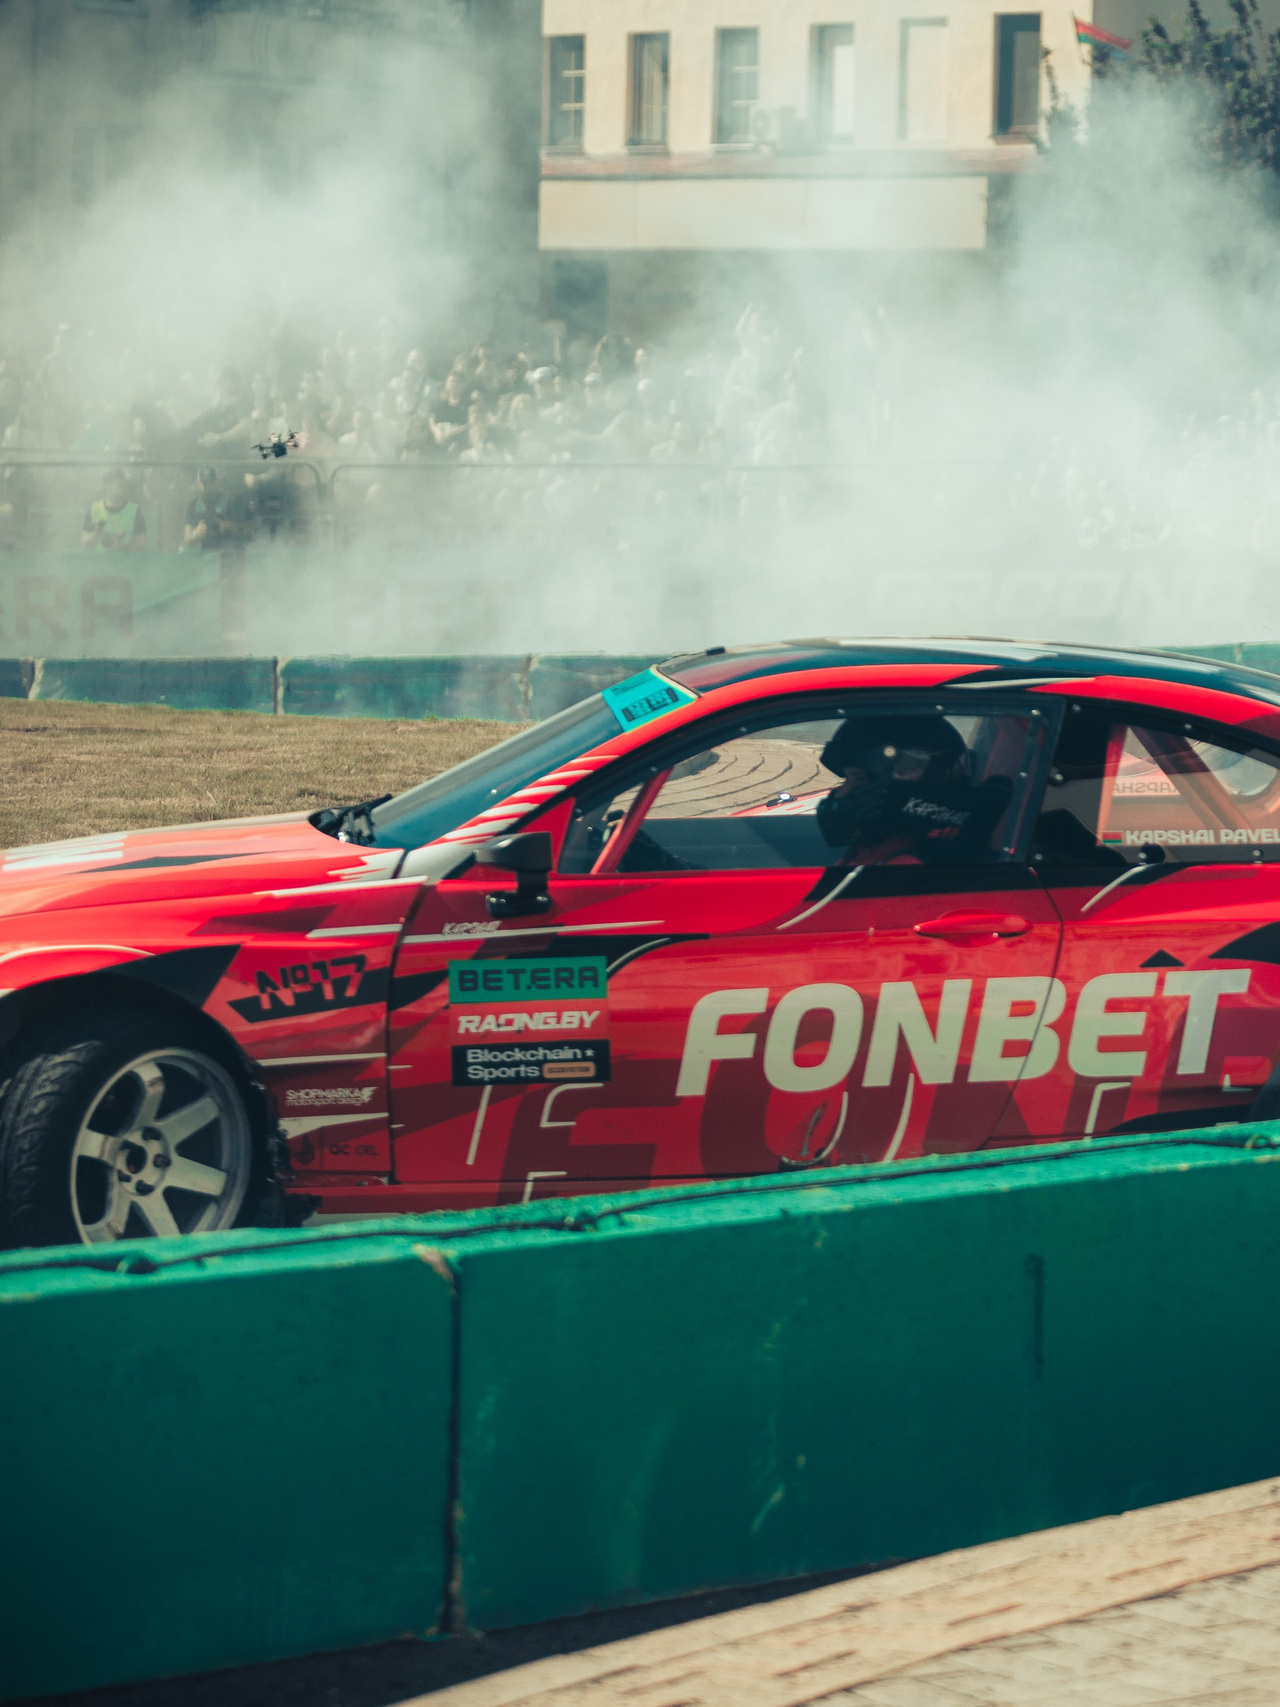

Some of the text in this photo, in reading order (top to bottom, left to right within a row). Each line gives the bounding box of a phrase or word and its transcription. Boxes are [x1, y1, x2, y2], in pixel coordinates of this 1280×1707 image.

[0, 576, 134, 640] RA
[1125, 829, 1215, 844] KAPSHAI
[675, 968, 1251, 1097] FONBET
[466, 1046, 583, 1063] Blockchain
[467, 1064, 541, 1081] Sports
